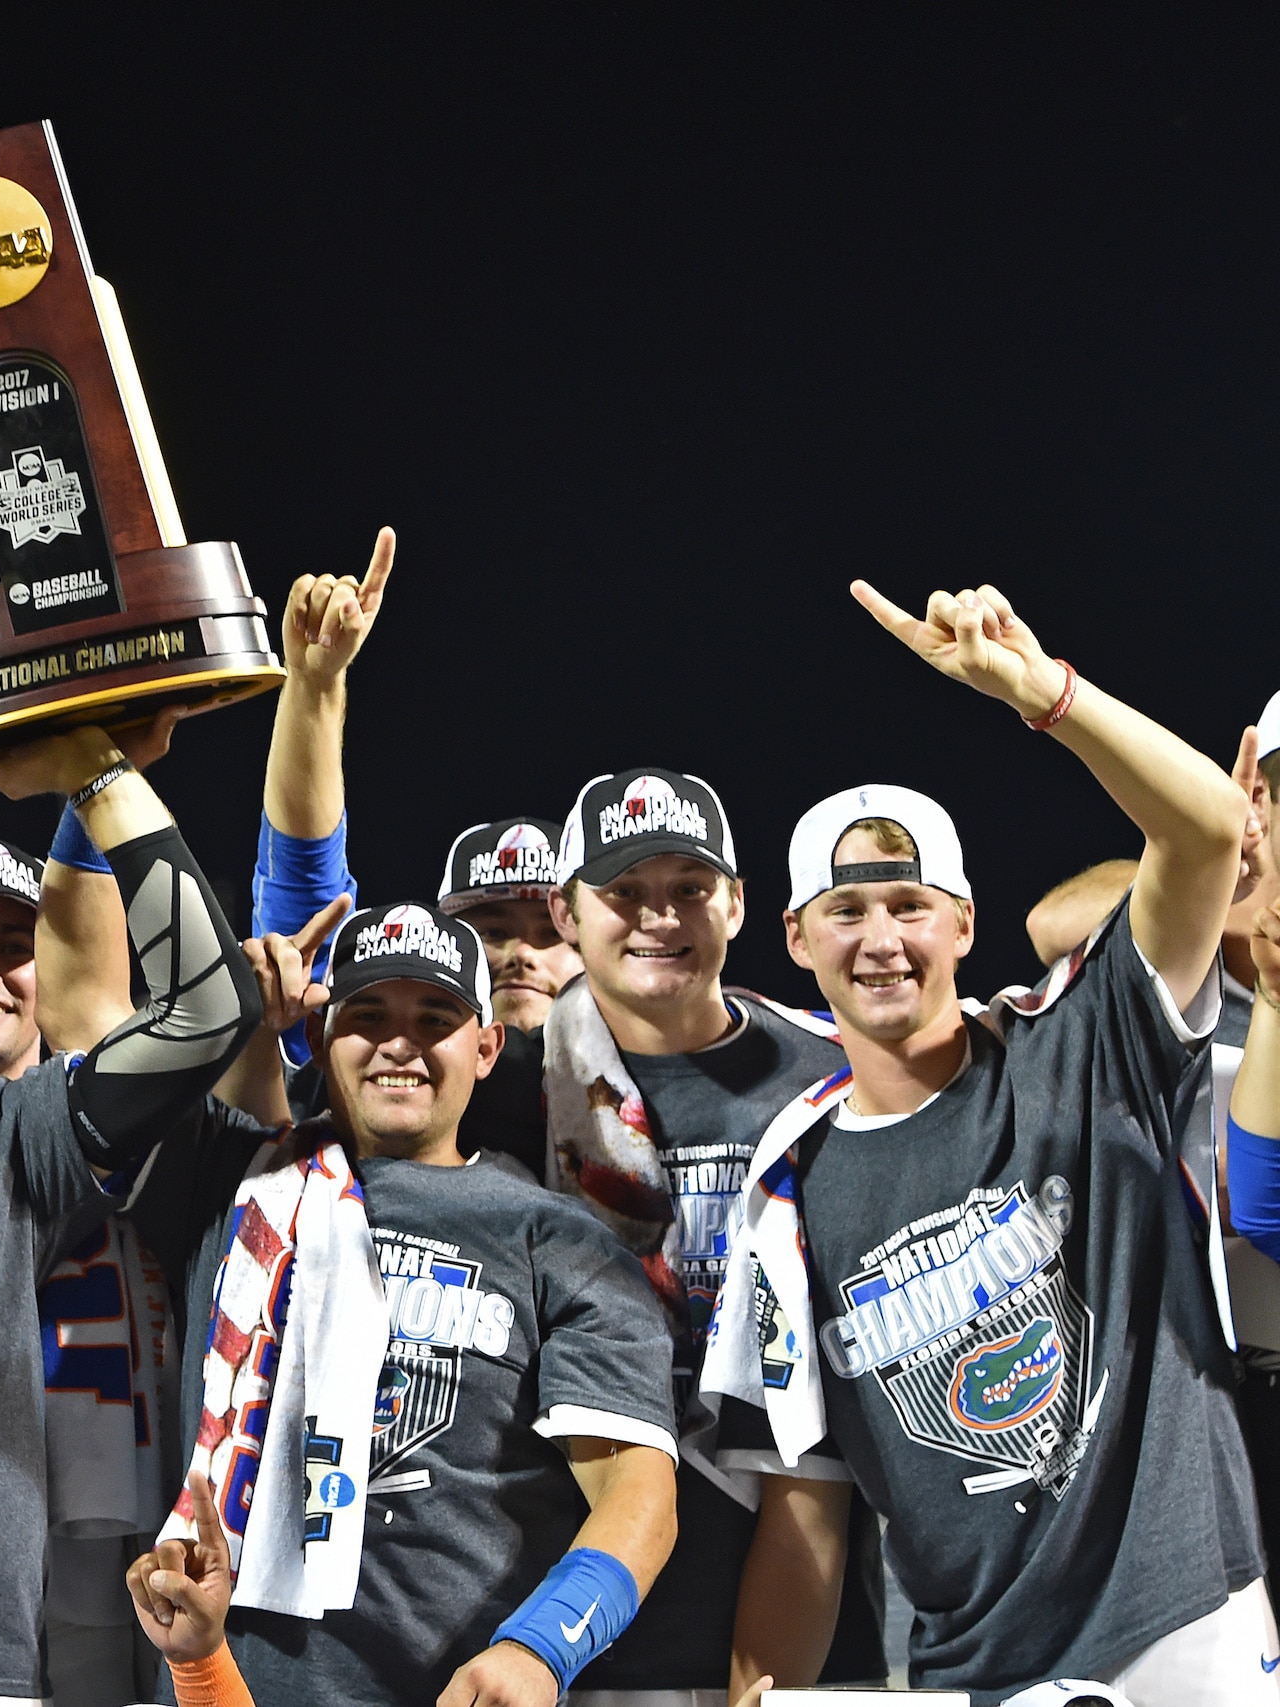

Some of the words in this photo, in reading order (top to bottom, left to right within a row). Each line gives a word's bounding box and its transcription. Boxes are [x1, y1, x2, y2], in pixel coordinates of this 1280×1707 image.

[53, 382, 60, 400] I
[0, 506, 39, 525] WORLD
[42, 497, 81, 516] SERIES
[14, 488, 61, 509] COLLEGE
[32, 568, 103, 599] BASEBALL
[35, 583, 109, 610] CHAMPIONSHIP
[75, 631, 185, 673] CHAMPION
[600, 814, 708, 845] CHAMPIONS
[354, 936, 462, 973] CHAMPIONS
[677, 1143, 728, 1161] DIVISION
[404, 1234, 460, 1258] BASEBALL
[859, 1244, 886, 1270] 2017
[909, 1207, 961, 1236] DIVISION
[880, 1202, 1000, 1290] NATIONAL
[376, 1243, 435, 1279] NAL
[819, 1174, 1074, 1379] CHAMPIONS
[898, 1322, 974, 1371] FLORIDA
